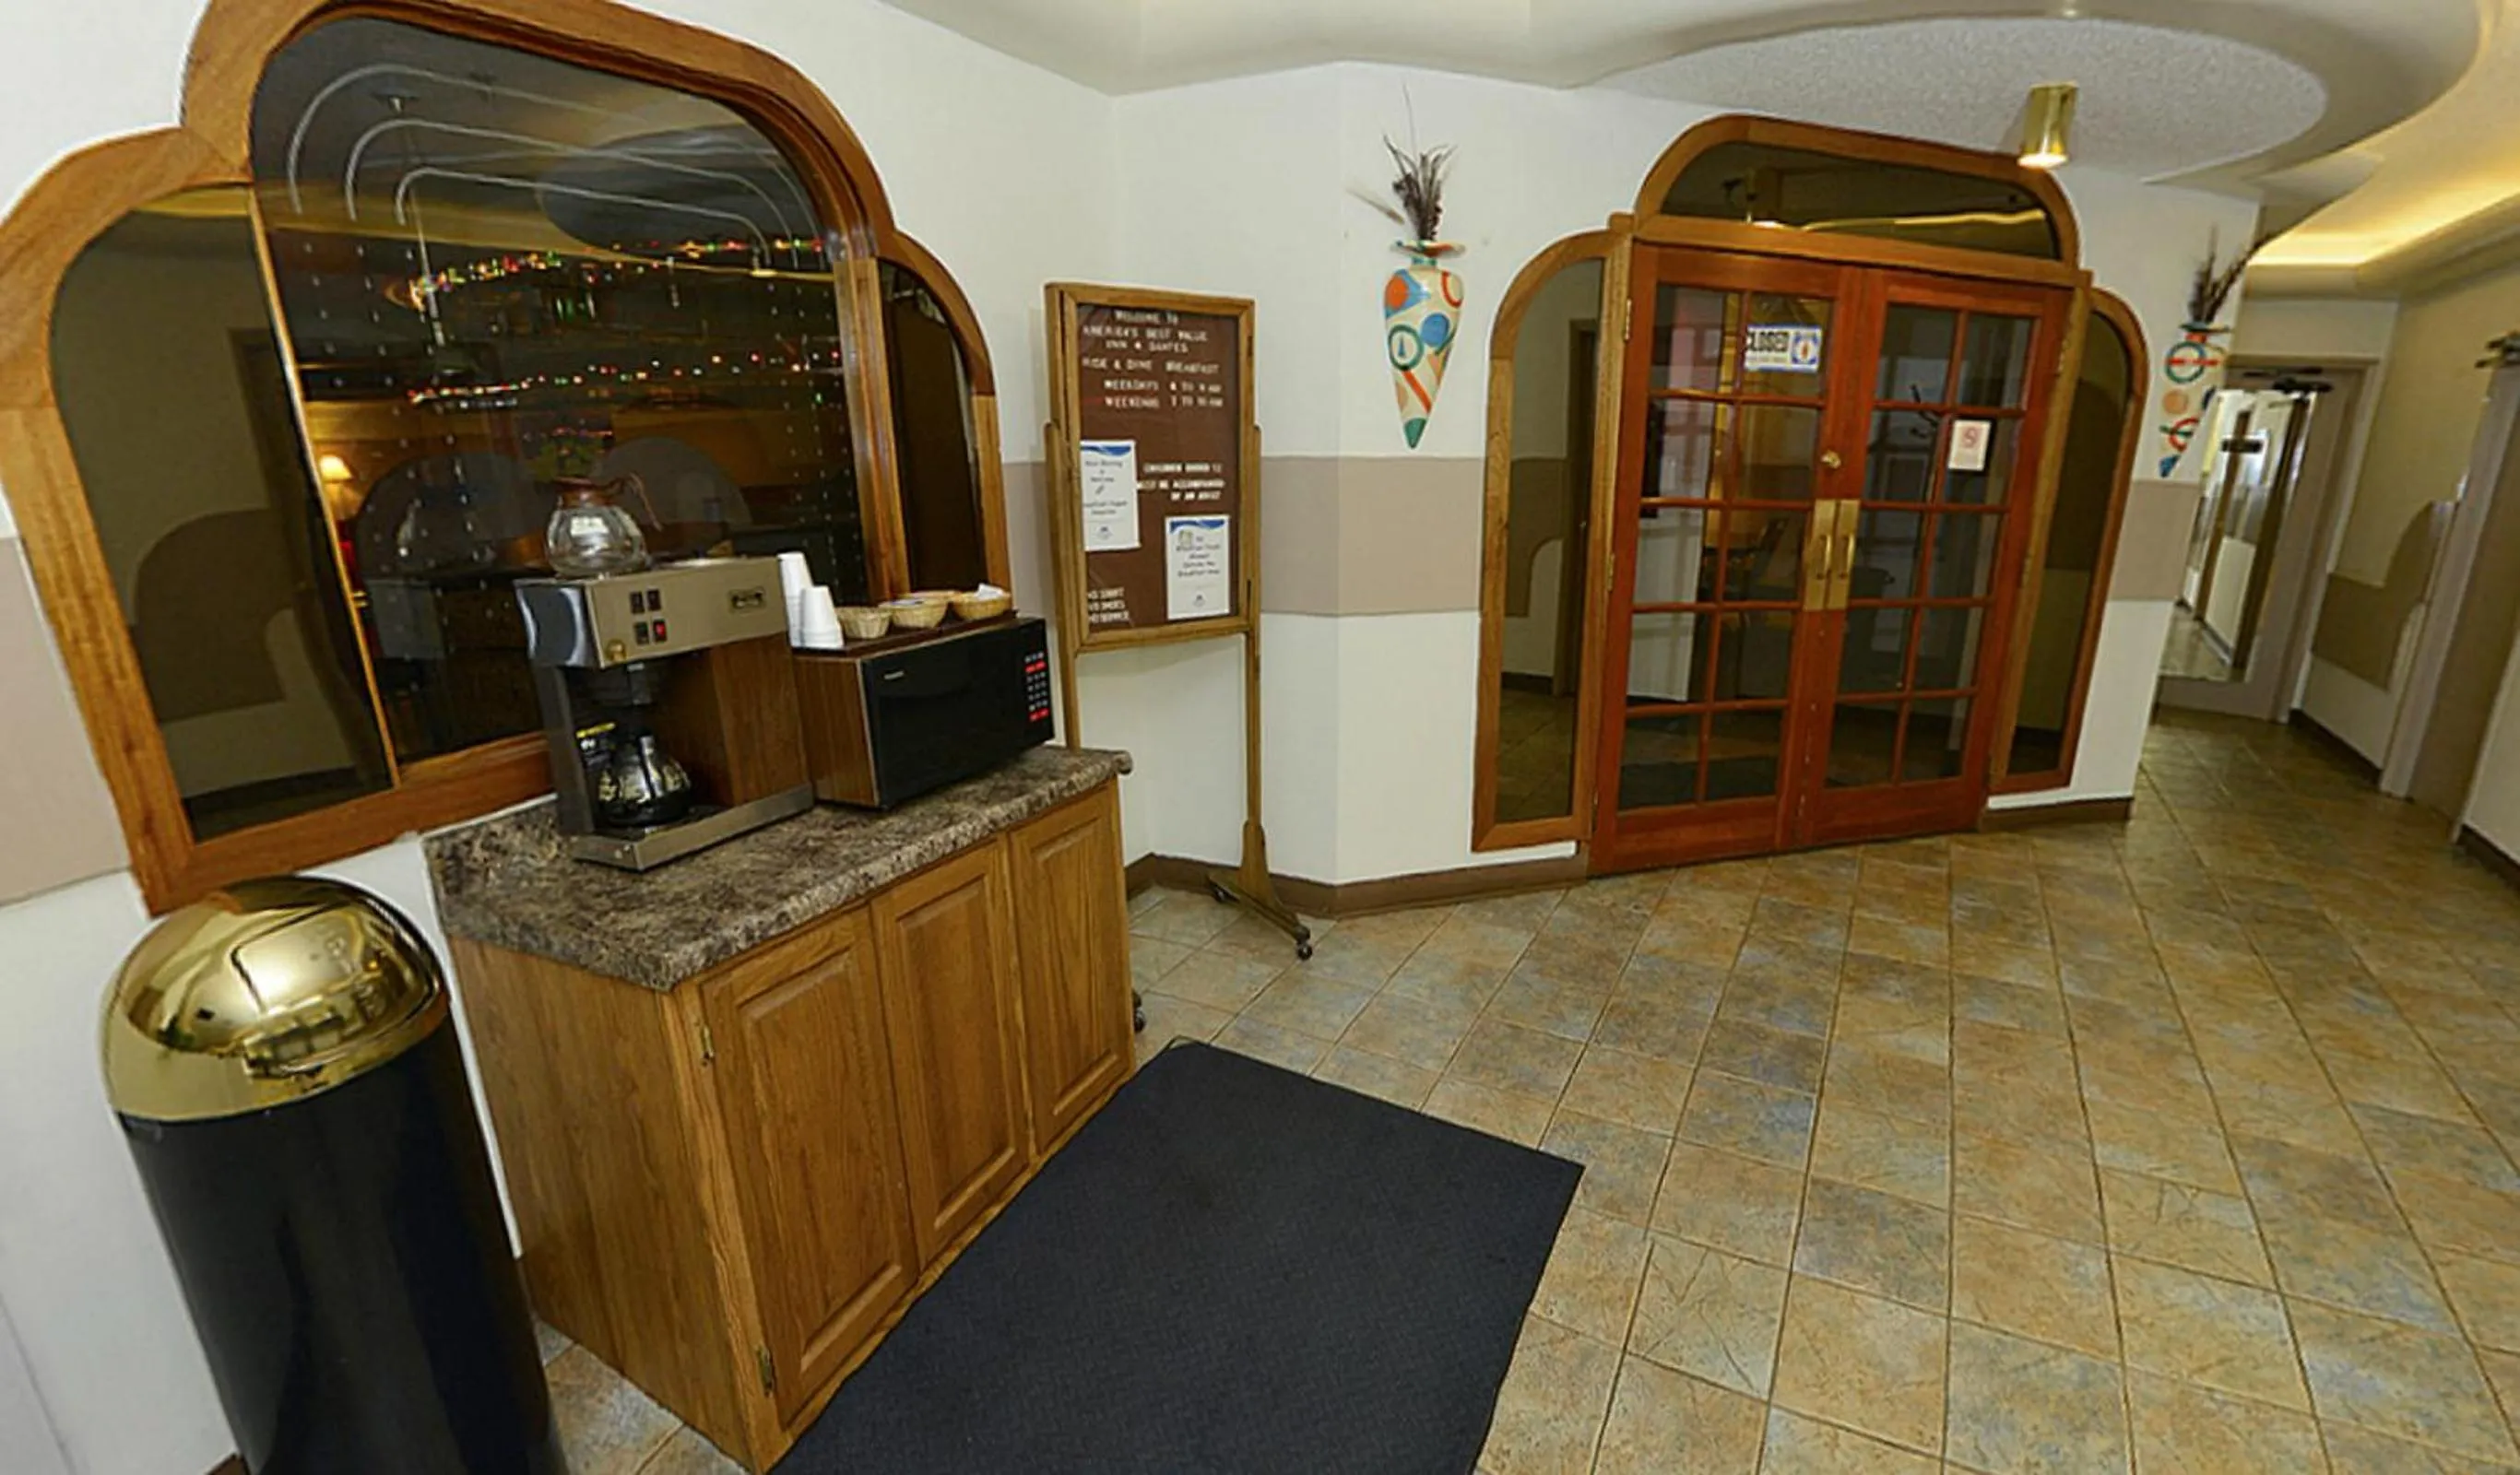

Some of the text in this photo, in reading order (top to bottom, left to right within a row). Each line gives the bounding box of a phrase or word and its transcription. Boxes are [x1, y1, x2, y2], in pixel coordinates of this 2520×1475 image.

[1145, 327, 1172, 340] BEST
[1177, 329, 1209, 342] VALUE
[1106, 340, 1128, 348] INN
[1104, 379, 1159, 391] WEEKDAYS
